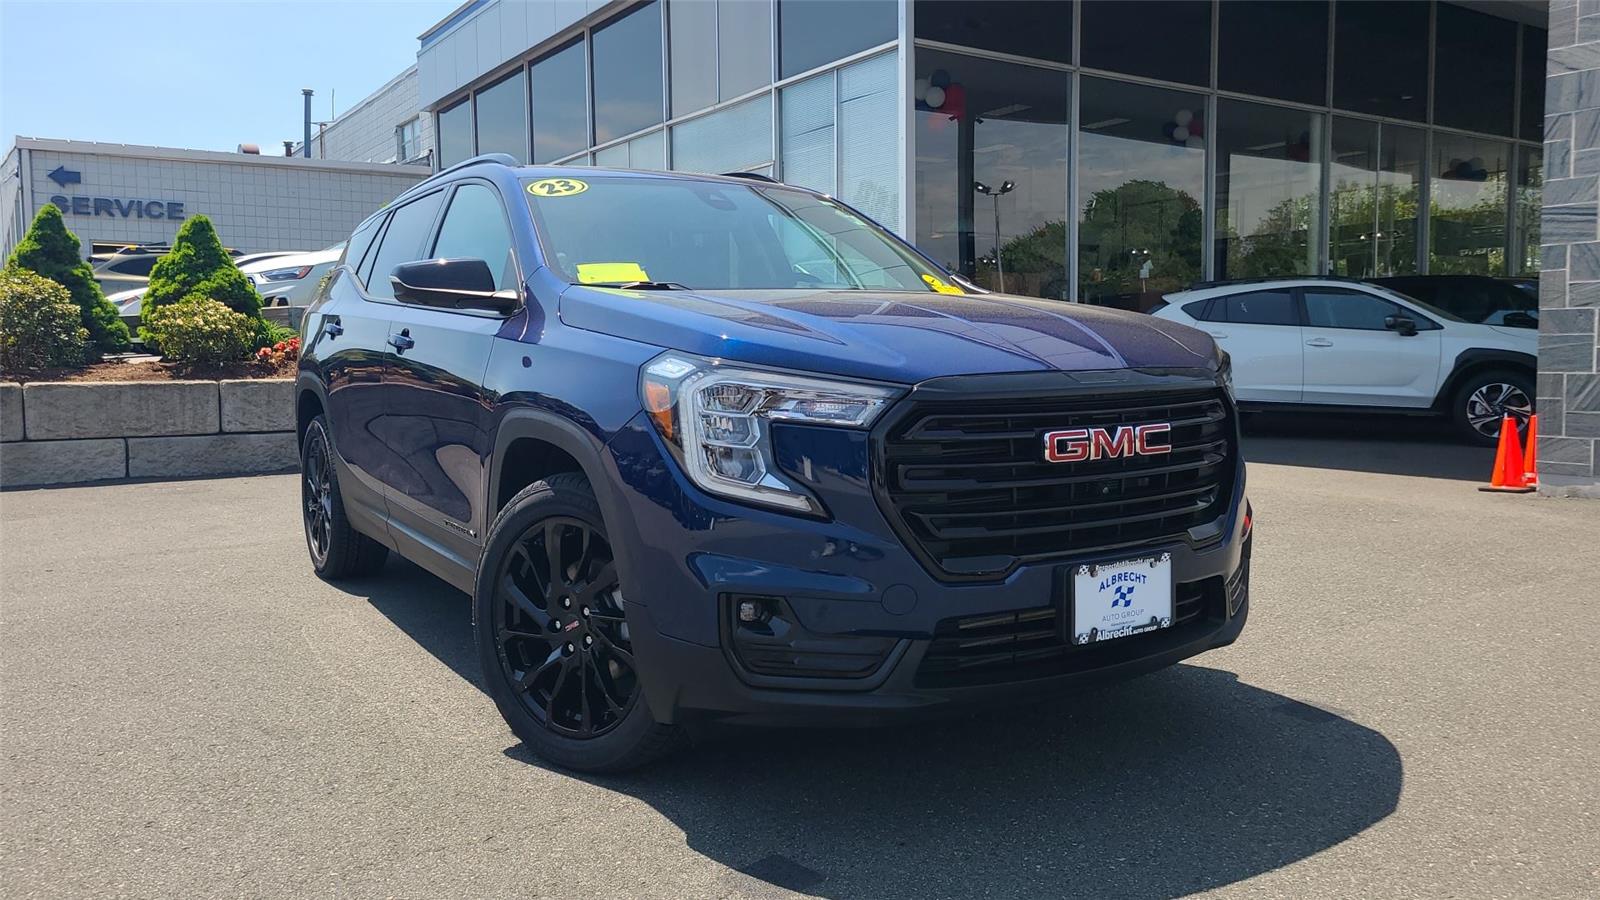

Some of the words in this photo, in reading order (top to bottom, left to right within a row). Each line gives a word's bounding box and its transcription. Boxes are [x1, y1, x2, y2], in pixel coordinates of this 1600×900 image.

[540, 180, 576, 195] 23
[50, 195, 185, 220] SERVICE
[1044, 423, 1172, 463] GMC
[1099, 572, 1147, 592] ALBRECHT
[1102, 611, 1120, 622] AUTO
[1121, 609, 1144, 619] GROUP
[1096, 626, 1133, 642] Albrecht
